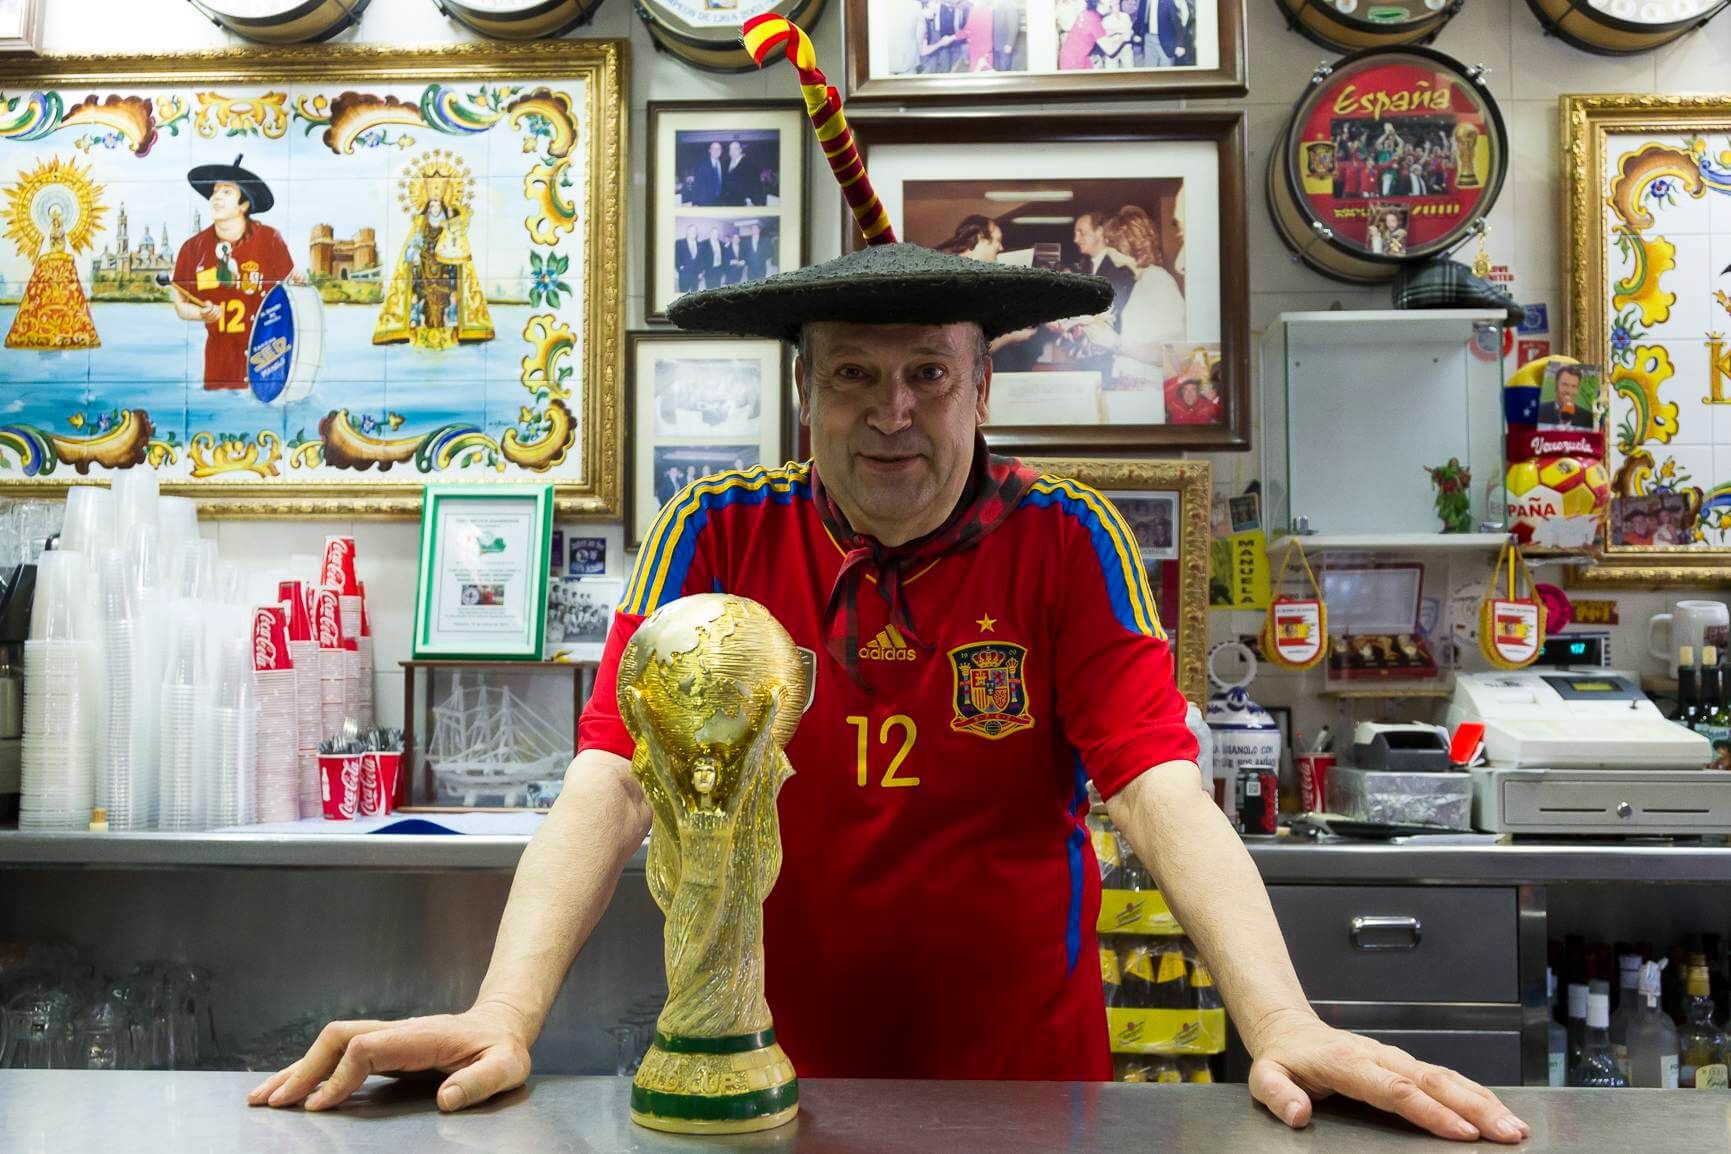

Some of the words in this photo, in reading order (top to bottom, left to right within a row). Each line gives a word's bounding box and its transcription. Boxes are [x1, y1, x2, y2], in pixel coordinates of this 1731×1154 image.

[1333, 81, 1451, 121] España
[1531, 436, 1594, 455] Venezuela
[1238, 540, 1256, 604] MANUELA
[858, 647, 917, 661] adidas
[846, 714, 920, 787] 12
